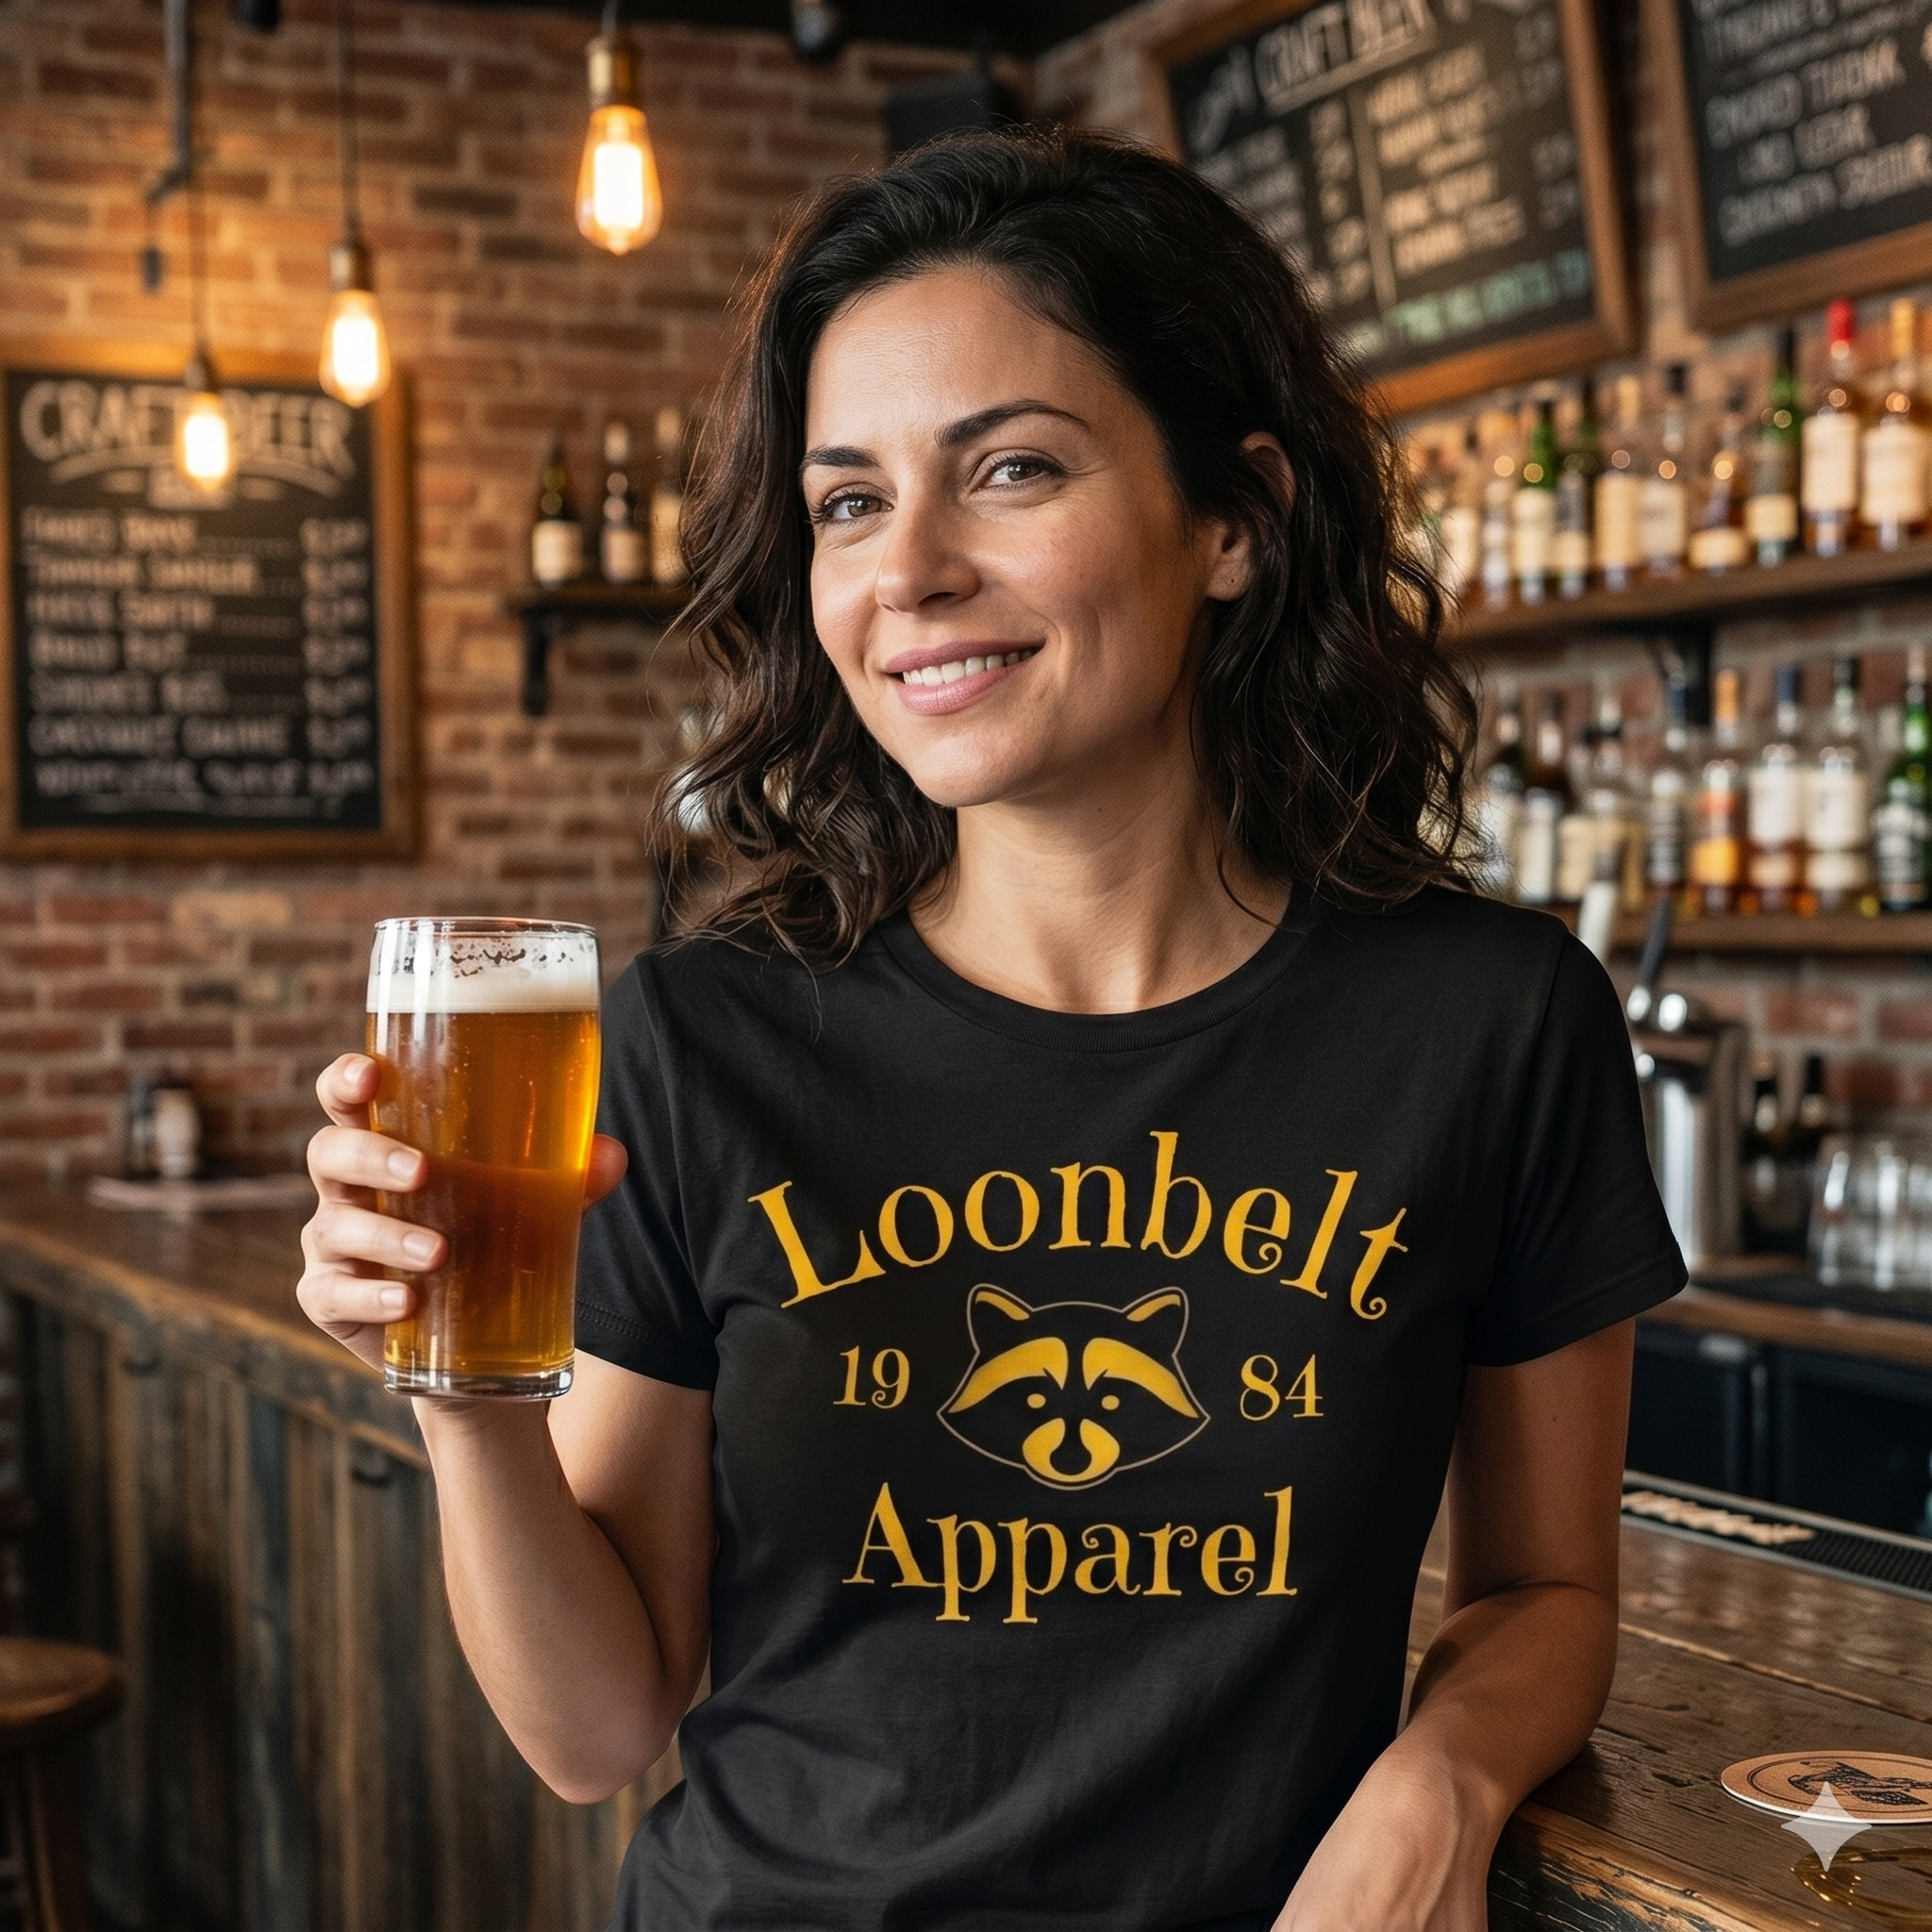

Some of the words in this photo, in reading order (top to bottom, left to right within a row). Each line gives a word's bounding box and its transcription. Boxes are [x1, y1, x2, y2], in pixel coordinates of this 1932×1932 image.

[748, 1130, 1408, 1321] Loonbelt
[832, 1345, 911, 1409] 19
[1239, 1354, 1324, 1422] 84
[842, 1482, 1298, 1624] Apparel
